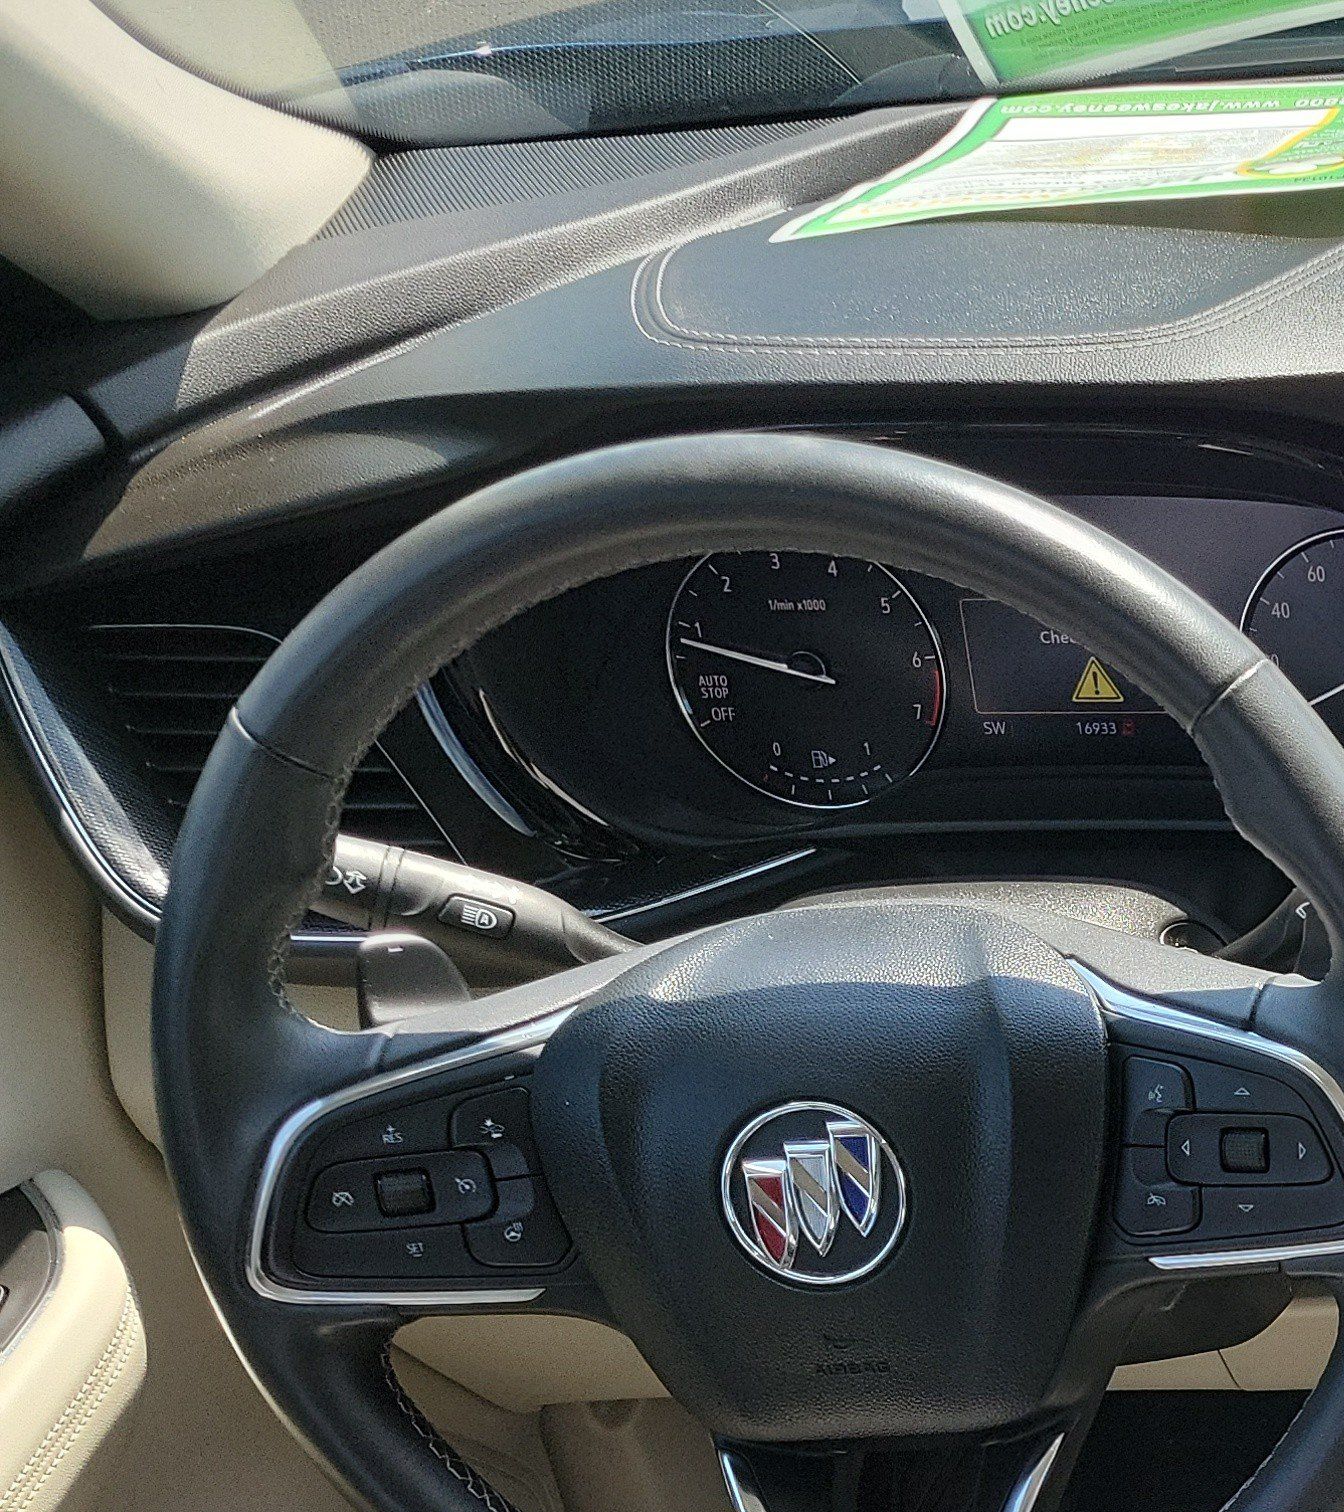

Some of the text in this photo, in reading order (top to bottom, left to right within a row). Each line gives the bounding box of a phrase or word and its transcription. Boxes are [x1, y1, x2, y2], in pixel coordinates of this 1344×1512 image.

[770, 553, 781, 570] 3
[827, 560, 838, 577] 4
[1307, 566, 1325, 583] 60
[721, 576, 733, 593] 2
[768, 599, 827, 613] 1/min x1000
[880, 598, 891, 615] 5
[1271, 602, 1290, 619] 40
[694, 621, 702, 637] 1
[1041, 630, 1076, 644] Che
[912, 652, 922, 669] 6
[698, 674, 728, 689] AUTO
[700, 685, 729, 699] STOP
[711, 707, 736, 722] OFF
[912, 704, 923, 720] 7
[983, 721, 1006, 735] SW
[1076, 721, 1117, 735] 16933
[772, 742, 782, 757] 0
[862, 742, 871, 756] 1
